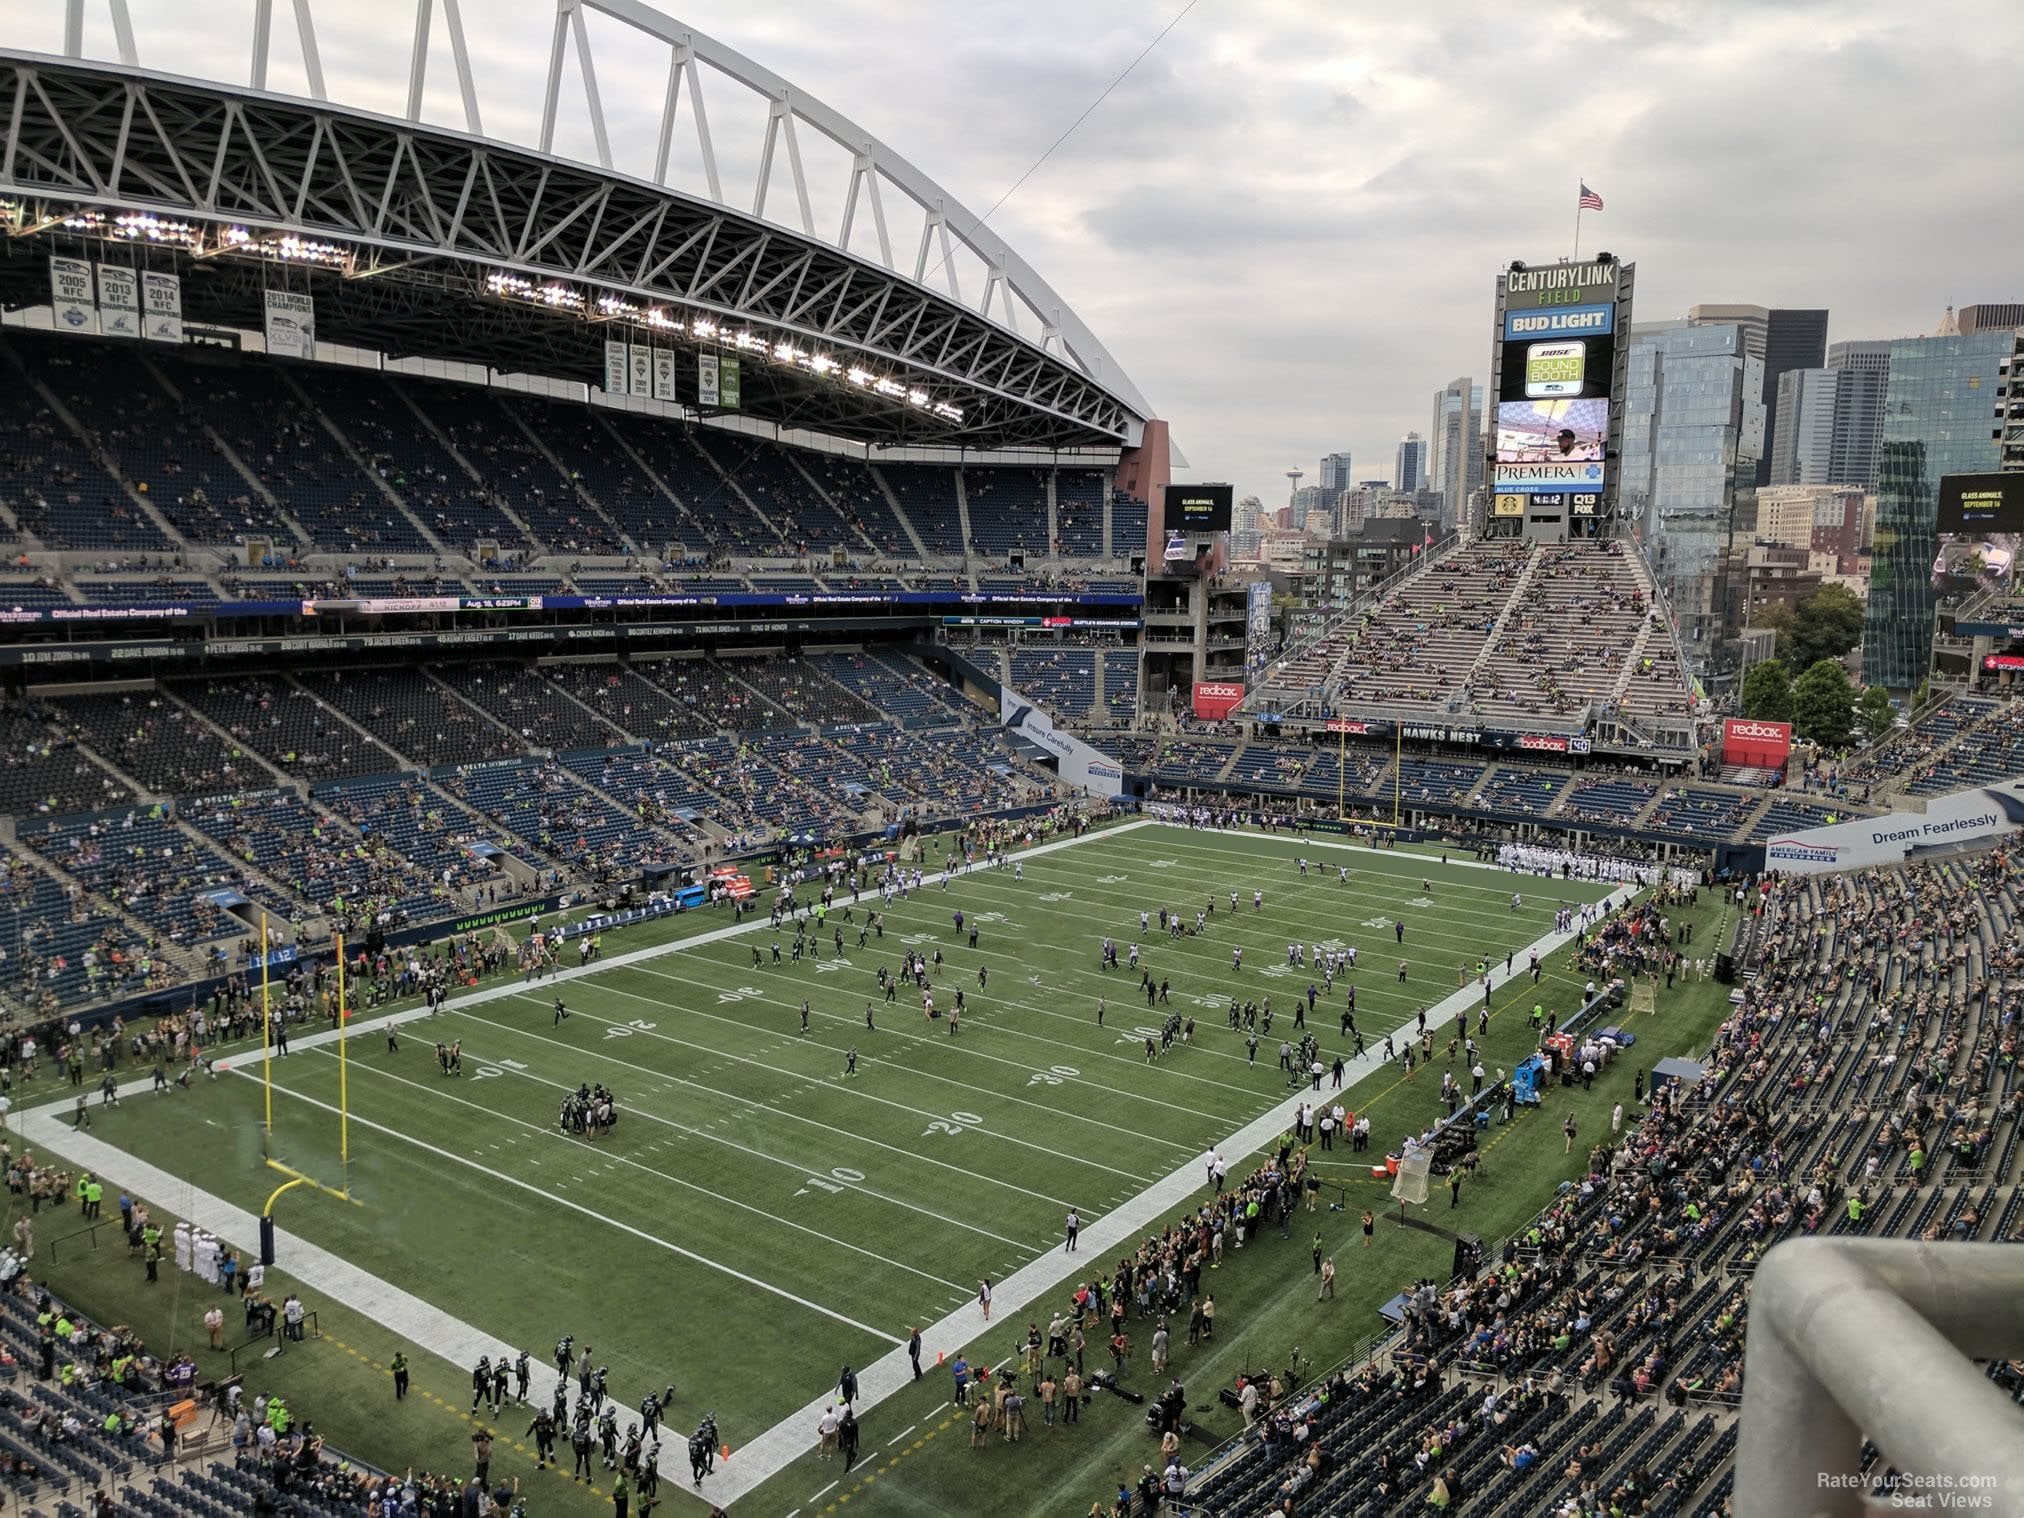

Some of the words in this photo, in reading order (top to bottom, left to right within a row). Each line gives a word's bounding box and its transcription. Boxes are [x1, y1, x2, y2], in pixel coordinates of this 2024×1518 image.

[58, 274, 86, 288] 2005
[1508, 263, 1614, 292] CENTURYLINK
[63, 286, 83, 297] NFC
[104, 282, 131, 295] 2013
[148, 288, 174, 301] 2014
[109, 294, 129, 304] NFC
[267, 291, 285, 302] 2013
[287, 294, 311, 305] WORLD
[1539, 289, 1580, 304] FIELD
[153, 301, 172, 310] NFC
[267, 300, 311, 313] CHAMPIONS
[1513, 317, 1549, 332] BUD
[1551, 312, 1604, 329] LIGHT
[1532, 360, 1579, 371] SOUND
[1532, 370, 1578, 382] BOOTH
[1498, 466, 1575, 480] PREMERA
[1574, 494, 1595, 504] Q13
[1574, 505, 1593, 514] FOX
[662, 598, 682, 606] Company
[52, 609, 81, 618] Official
[83, 609, 100, 617] Real
[102, 609, 128, 617] Estate
[129, 608, 164, 618] Company
[165, 608, 173, 616] of
[509, 632, 516, 640] 17
[576, 630, 592, 638] CHUCK
[111, 649, 123, 658] 22
[143, 647, 169, 657] BROWN
[210, 644, 226, 653] PETE
[22, 653, 35, 662] 10
[839, 723, 857, 731] DELTA
[1027, 721, 1046, 738] Insure
[1046, 732, 1074, 755] Carefully
[1403, 728, 1445, 740] HAWKS
[1450, 731, 1481, 743] NEST
[1573, 741, 1587, 751] 40
[1872, 828, 1920, 845] Dream
[1923, 813, 1998, 837] Fearlessly
[1770, 846, 1808, 855] AMERICAN
[1810, 849, 1838, 857] FAMILY
[1773, 853, 1832, 862] INSURANCE
[279, 949, 291, 961] 12
[719, 986, 763, 1002] 30
[607, 1019, 656, 1037] 20
[476, 1058, 528, 1077] 10
[1031, 1065, 1080, 1085] 30
[928, 1112, 983, 1135] 20
[807, 1167, 865, 1194] 10
[644, 1405, 656, 1416] 77
